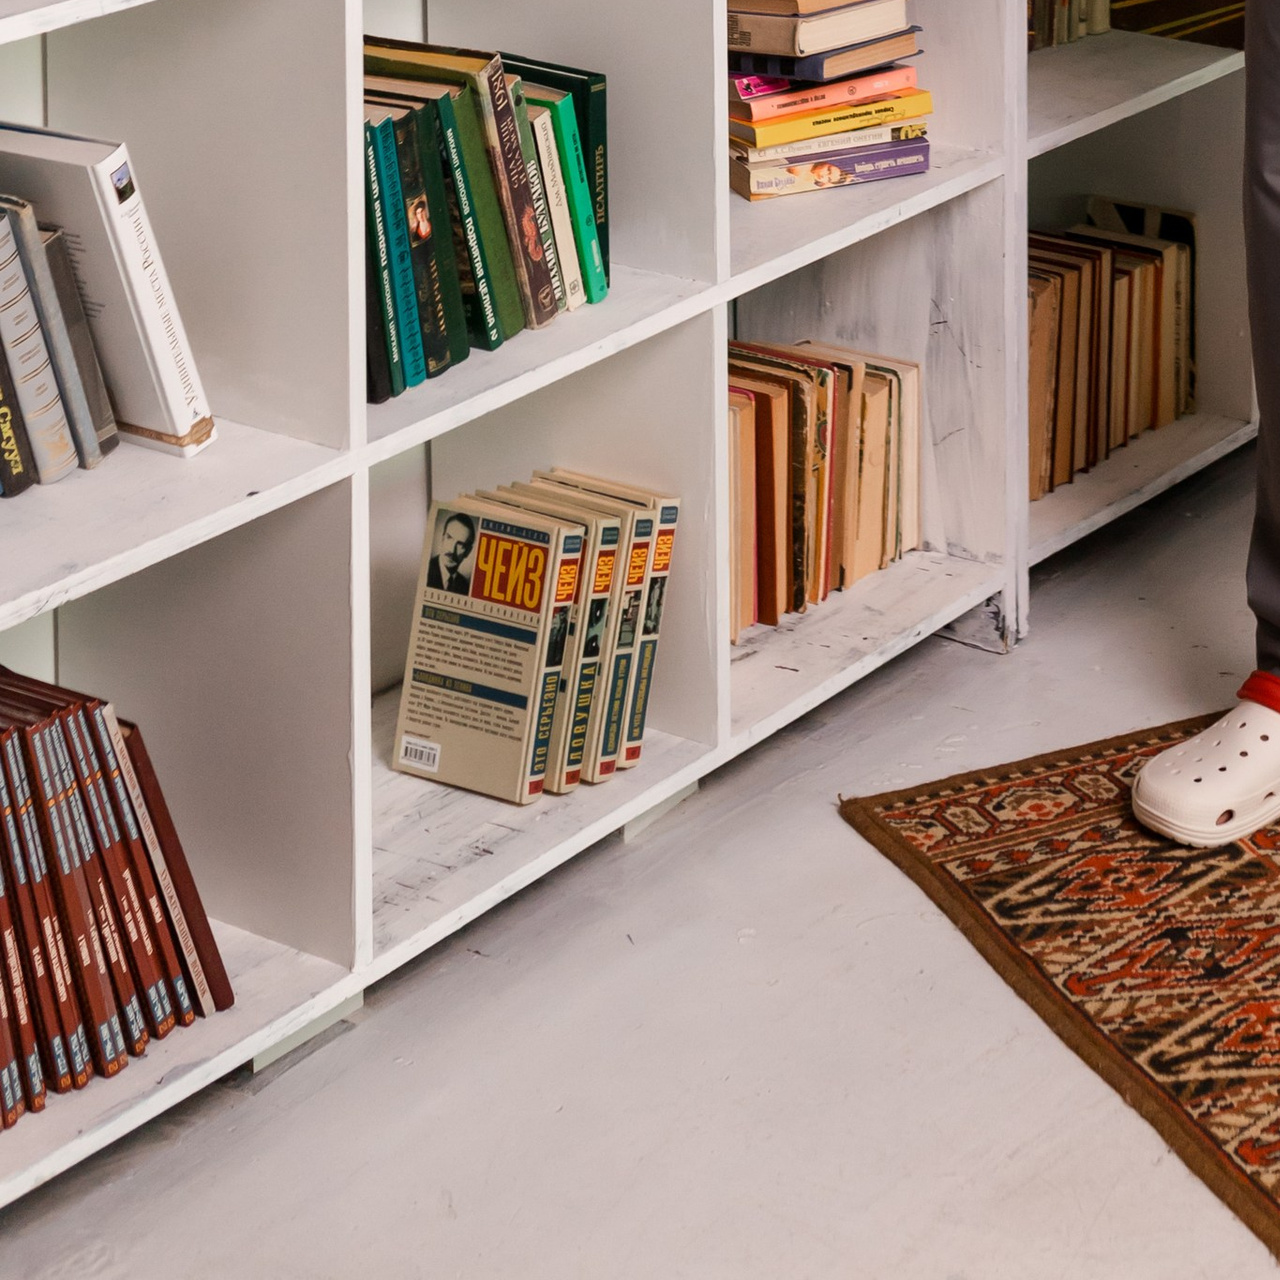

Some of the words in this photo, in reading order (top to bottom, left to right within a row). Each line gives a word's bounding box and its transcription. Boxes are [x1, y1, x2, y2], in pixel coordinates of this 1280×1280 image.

[852, 131, 884, 147] ОНЕГИН
[367, 144, 381, 200] ЦЕЛИНА
[526, 159, 552, 236] БУЛГАКОВ
[595, 143, 605, 226] ПСАЛТИРЬ
[132, 214, 157, 272] РОССИИ
[373, 201, 388, 269] ПОДНЯТАЯ
[446, 127, 460, 168] МИХАИЛ
[456, 168, 470, 216] ШОЛОХОВ
[465, 217, 484, 280] ПОДНЯТАЯ
[478, 279, 496, 328] ЦЕЛИНА
[489, 327, 499, 342] 2
[148, 266, 167, 309] МЕСТА
[382, 269, 395, 320] ШОЛОХОВ
[544, 237, 567, 303] МИХАИЛ
[161, 310, 199, 407] УДИВИТЕЛЬНЫЕ
[388, 319, 400, 363] МИХАИЛ
[477, 534, 546, 609] ЧЕЙЗ
[595, 554, 616, 592] ЧЕЙЗ
[630, 545, 649, 584] ЧЕЙЗ
[653, 533, 674, 570] ЧЕЙЗ
[557, 563, 578, 601] ЧЕЙЗ
[537, 673, 559, 739] СЕРЬЕЗНО
[570, 665, 597, 761] ЛОВУШКА
[534, 743, 550, 773] ЭТО
